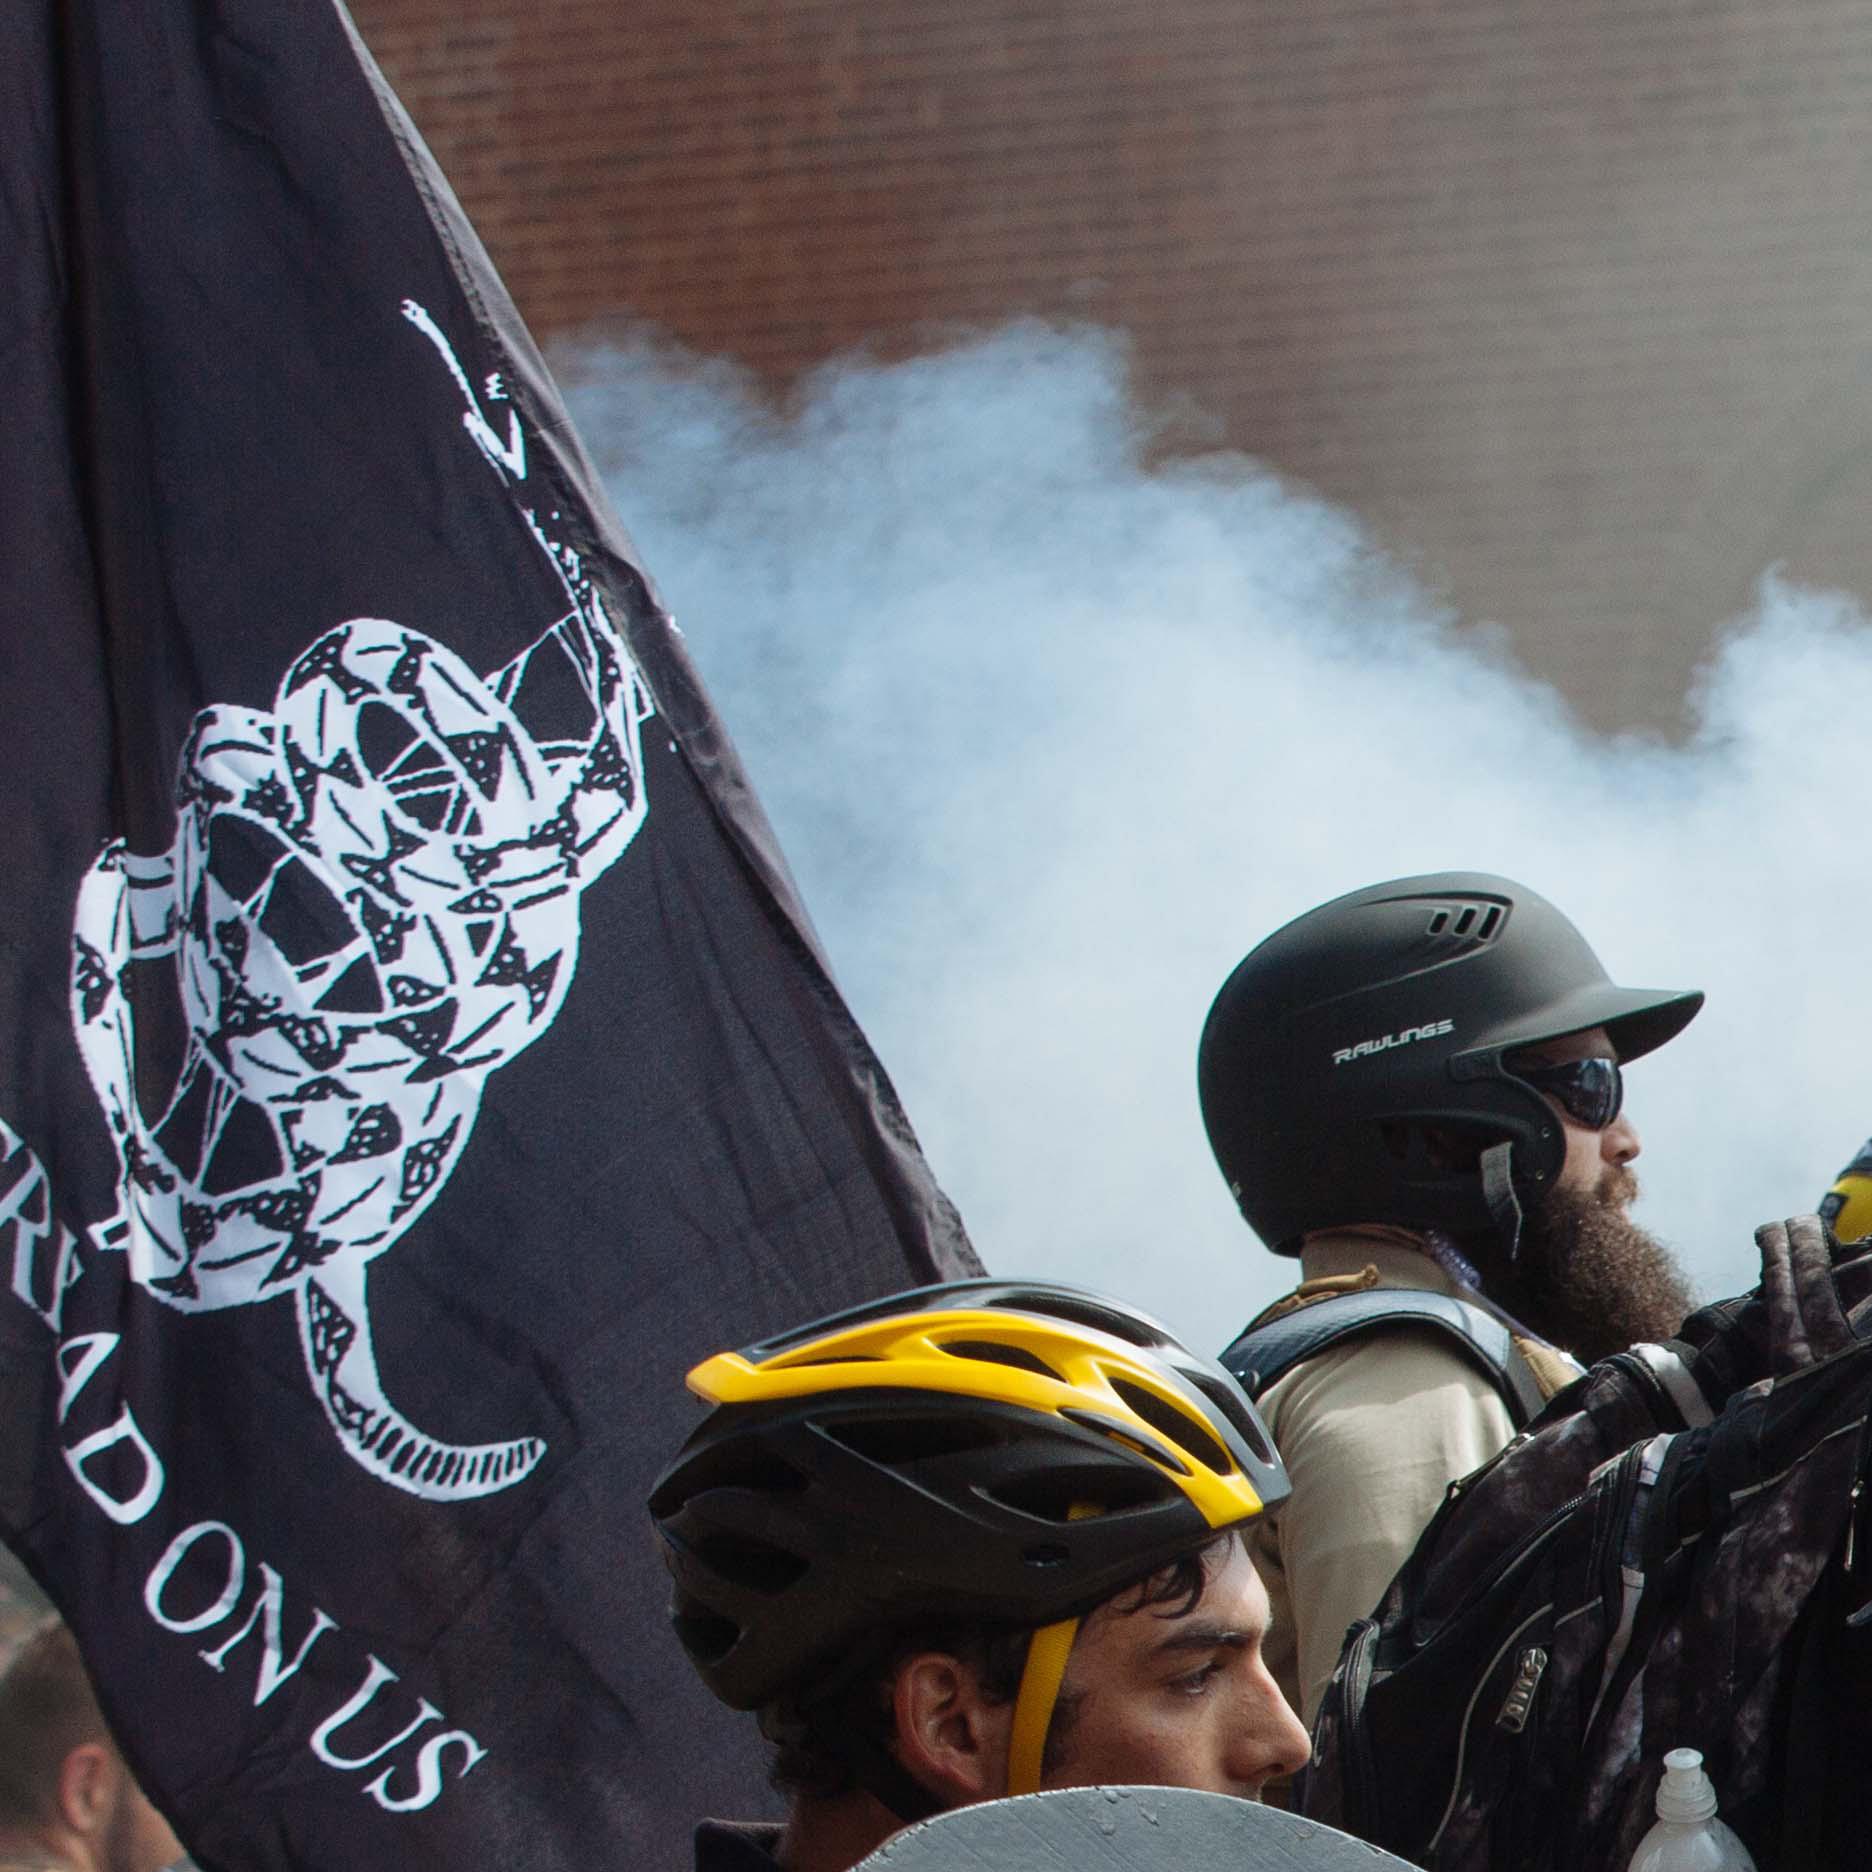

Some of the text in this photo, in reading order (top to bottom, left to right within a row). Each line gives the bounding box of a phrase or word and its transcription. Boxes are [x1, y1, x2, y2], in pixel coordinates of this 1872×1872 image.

[1332, 1019, 1456, 1064] RAWLINGS
[144, 1520, 340, 1706] ON
[310, 1653, 489, 1812] US
